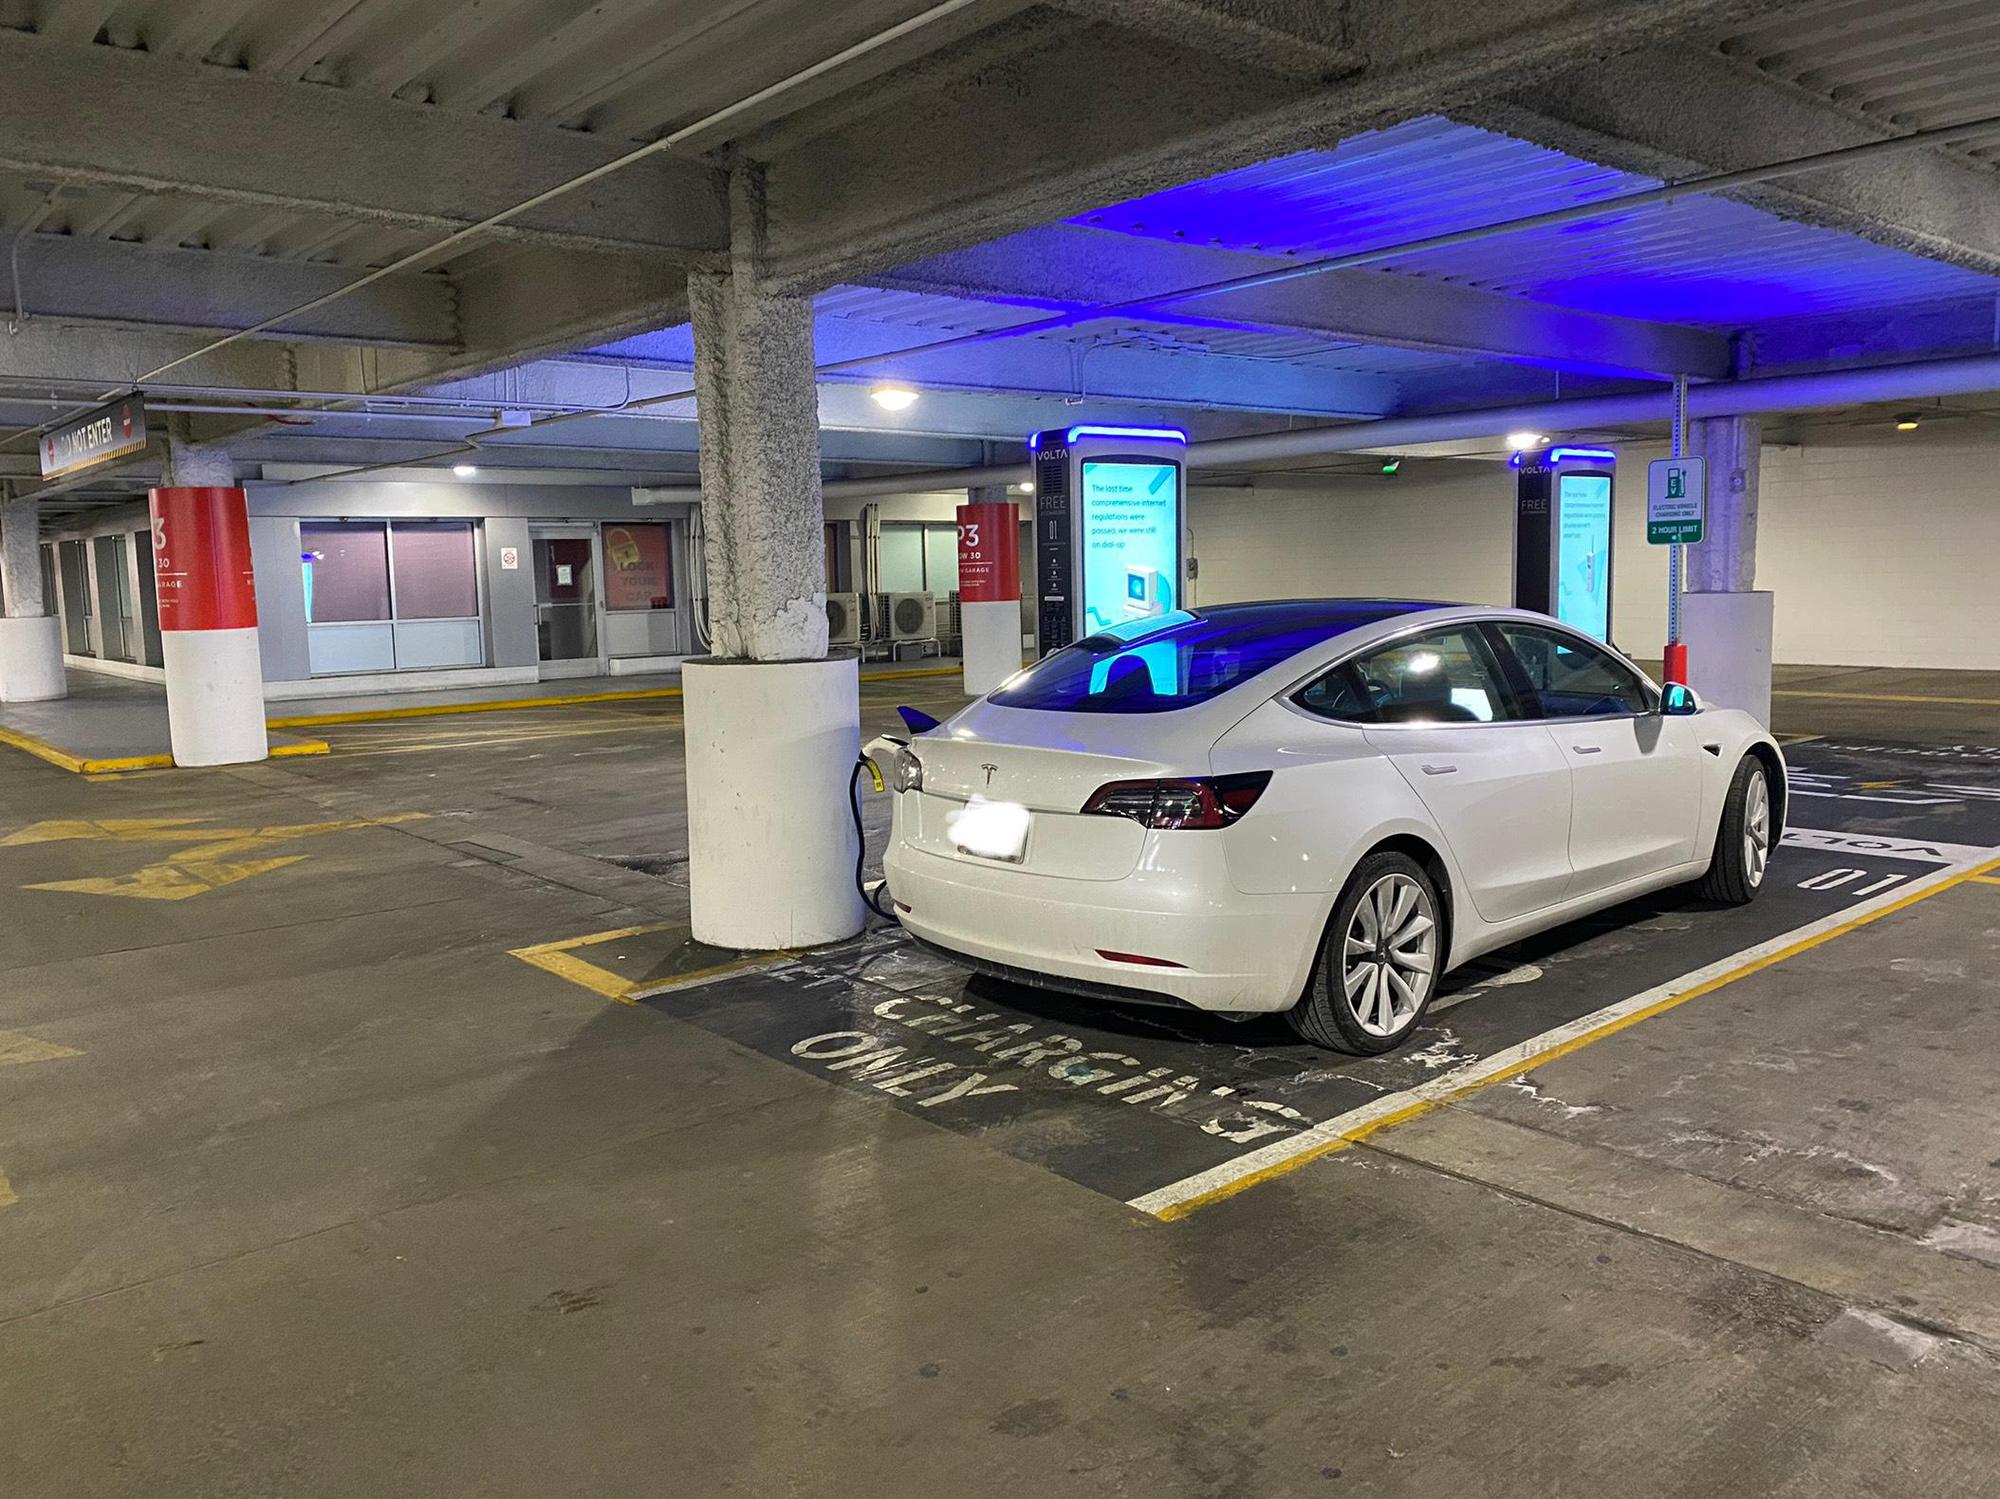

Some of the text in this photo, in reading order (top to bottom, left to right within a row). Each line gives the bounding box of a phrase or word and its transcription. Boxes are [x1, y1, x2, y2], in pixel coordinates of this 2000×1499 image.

[72, 426, 87, 452] NOT
[87, 416, 113, 449] ENTER
[1037, 449, 1068, 461] VOLTA
[1520, 466, 1551, 474] VOLTA
[1040, 495, 1066, 509] FREE
[1092, 499, 1167, 507] comprehensive internet
[1521, 498, 1547, 510] FREE
[1092, 513, 1129, 521] regulations
[1658, 525, 1678, 534] HOUR
[1679, 524, 1698, 533] LIMIT
[158, 557, 170, 568] 30
[1797, 868, 1908, 896] 01
